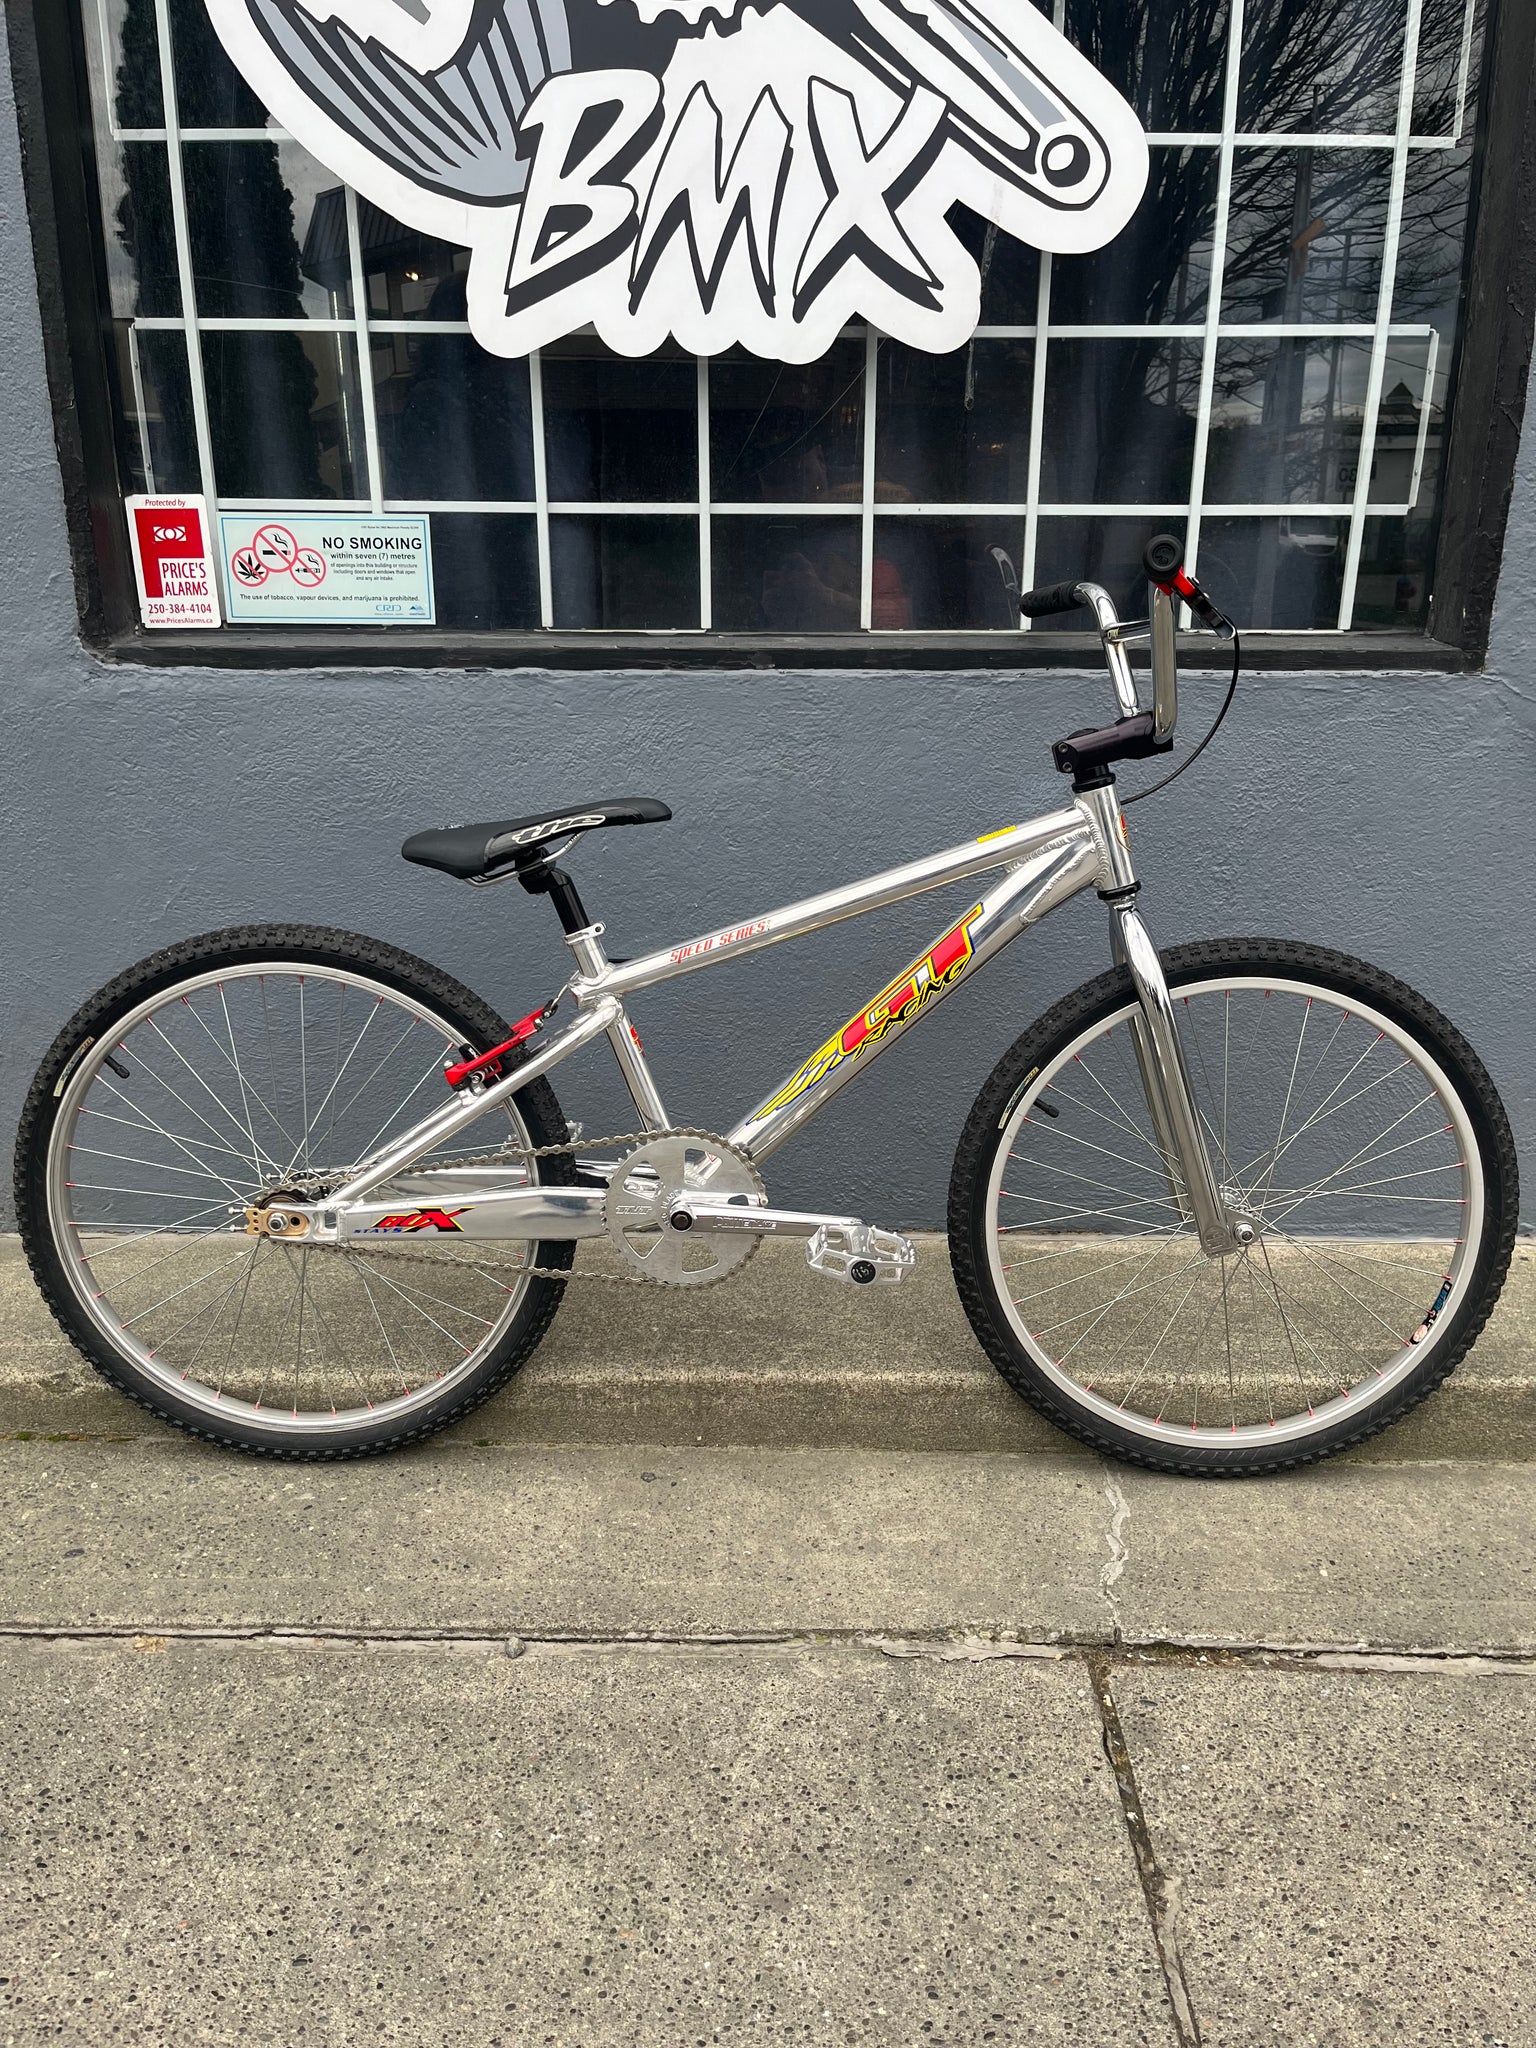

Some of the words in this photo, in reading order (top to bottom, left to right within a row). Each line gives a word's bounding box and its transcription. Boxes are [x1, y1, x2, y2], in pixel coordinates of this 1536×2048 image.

[507, 68, 949, 320] BMX
[144, 499, 177, 507] Protected
[177, 499, 186, 508] by
[322, 536, 345, 549] NO
[349, 537, 422, 550] SMOKING
[330, 552, 353, 560] within
[378, 552, 389, 561] (7)
[162, 562, 206, 579] PRICE'S
[165, 581, 209, 596] ALARMS
[297, 594, 316, 602] vapour
[317, 594, 341, 602] devices,
[354, 594, 382, 602] marijuana
[147, 603, 212, 614] 250-384-4104
[512, 814, 606, 845] the
[719, 921, 767, 946] SERIES
[838, 902, 985, 1056] GT
[852, 951, 973, 1062] RACING
[371, 1205, 476, 1233] BOX
